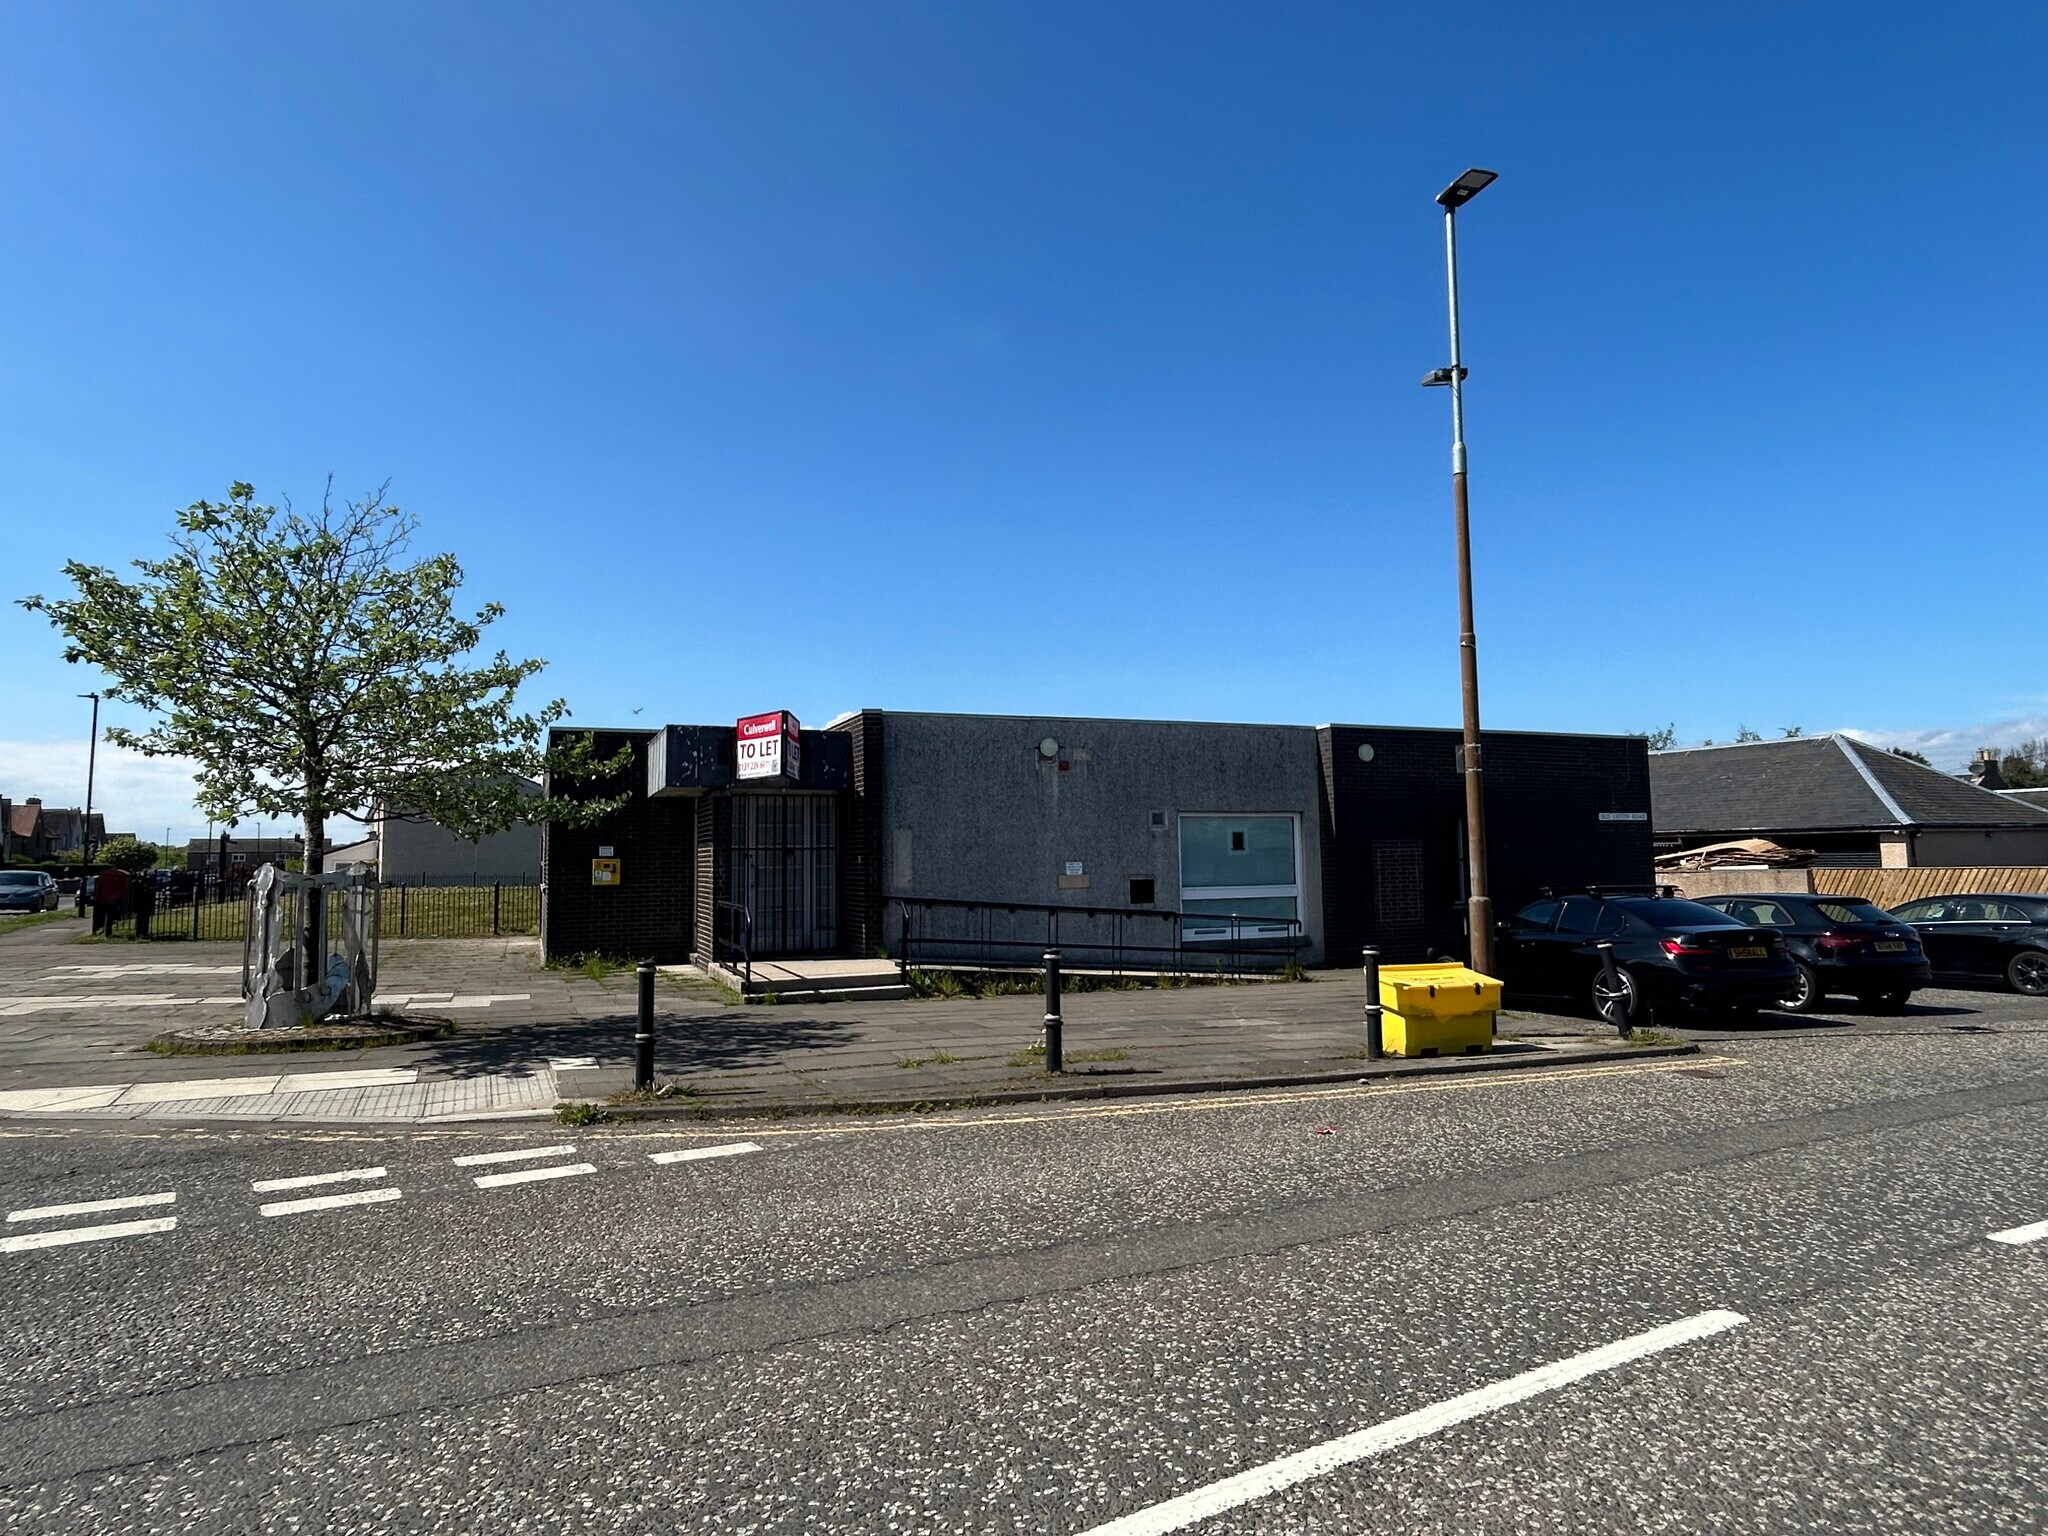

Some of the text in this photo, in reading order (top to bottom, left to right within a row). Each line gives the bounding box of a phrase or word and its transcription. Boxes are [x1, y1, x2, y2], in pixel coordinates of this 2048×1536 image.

[743, 720, 776, 735] Culverwell
[740, 743, 756, 759] TO
[760, 739, 779, 757] LET
